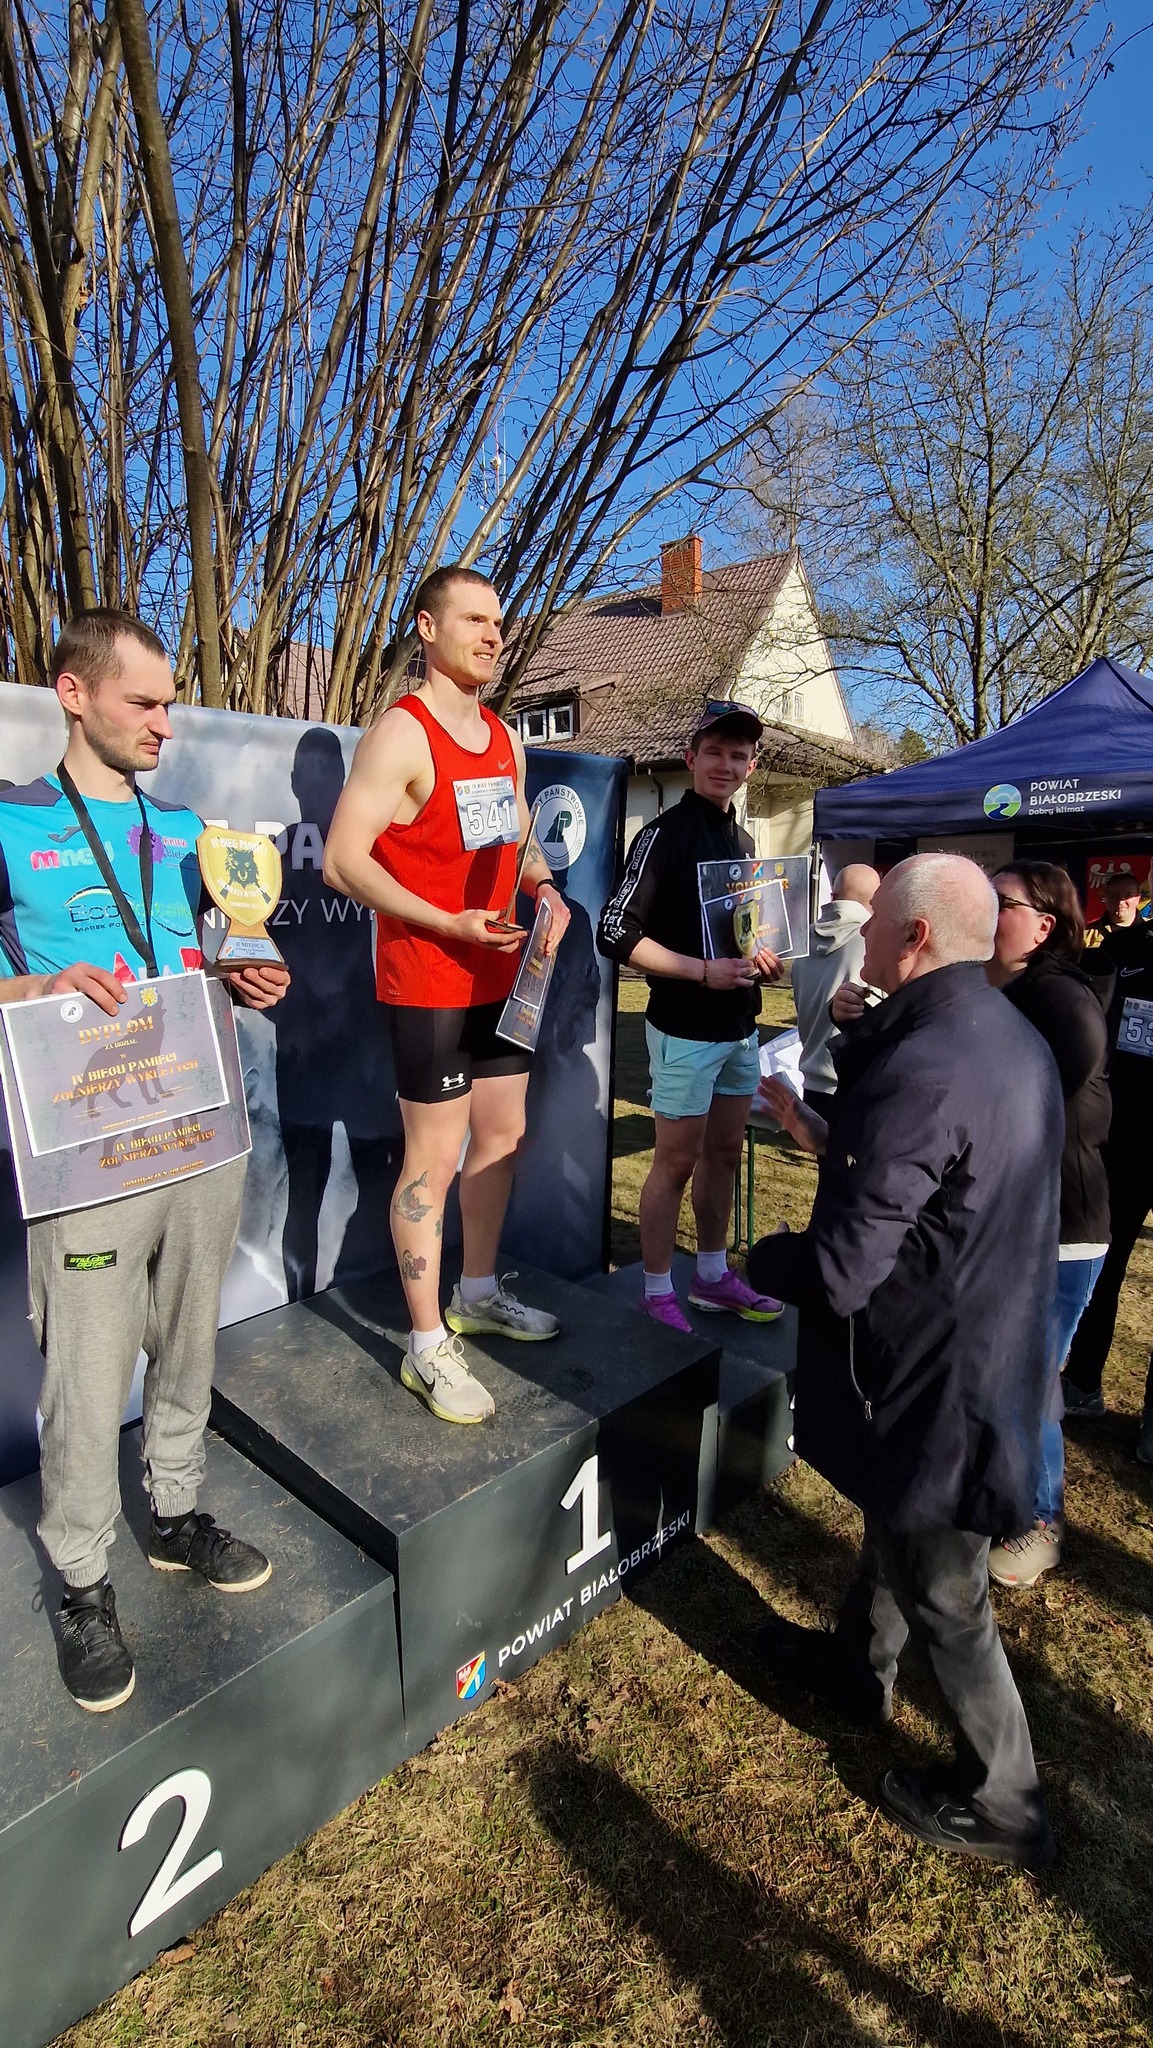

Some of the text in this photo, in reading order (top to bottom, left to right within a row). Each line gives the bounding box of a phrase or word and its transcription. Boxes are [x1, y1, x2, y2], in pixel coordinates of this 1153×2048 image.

[1030, 779, 1080, 792] POWIAT
[1030, 789, 1122, 806] BIAŁOBRZESKI
[466, 799, 512, 836] 541
[1028, 806, 1085, 815] Dobry klimat
[78, 1015, 154, 1045] DYPLOM
[72, 1074, 84, 1086] IV
[560, 1454, 612, 1575] 1
[498, 1509, 691, 1667] POWIAT BIAŁOBRZESKI
[118, 1766, 224, 1939] 2
